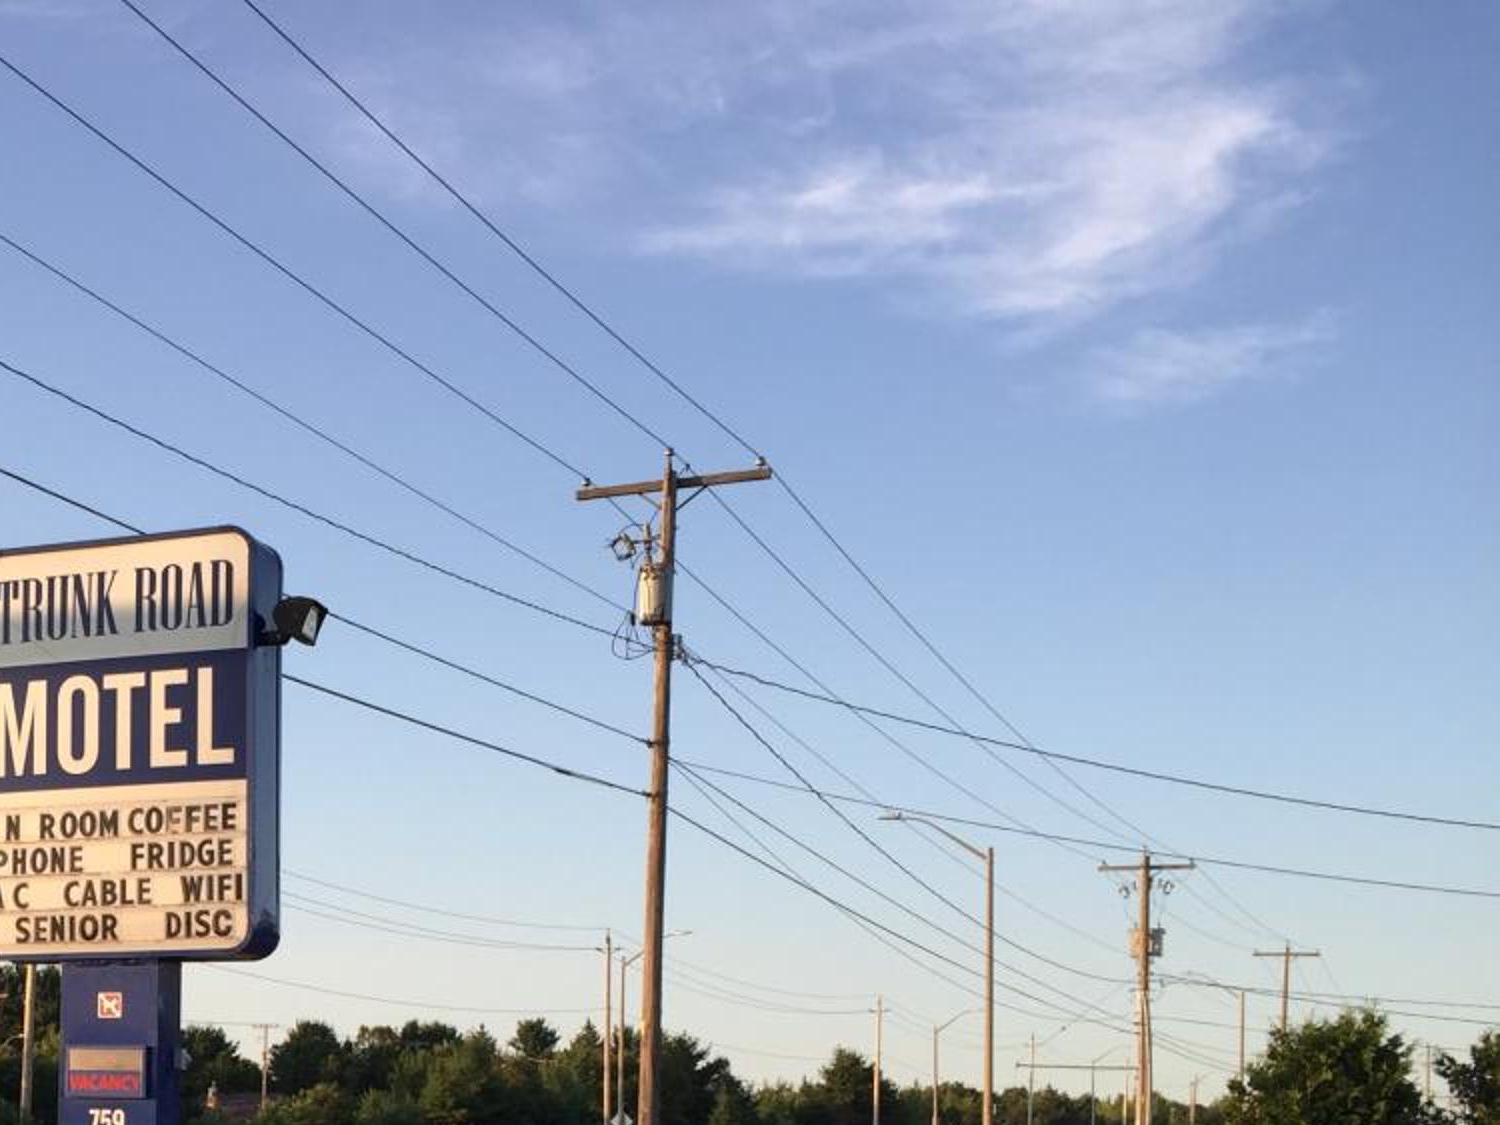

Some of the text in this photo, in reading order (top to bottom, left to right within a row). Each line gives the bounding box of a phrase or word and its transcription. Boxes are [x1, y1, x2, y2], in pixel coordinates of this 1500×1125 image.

[134, 559, 234, 633] ROAD
[39, 810, 119, 839] ROOM
[127, 803, 237, 834] COFFEE
[131, 839, 233, 870] FRIDGE
[63, 878, 151, 907] CABLE
[180, 873, 243, 902] WIFI
[15, 910, 233, 943] SENIOR DISC
